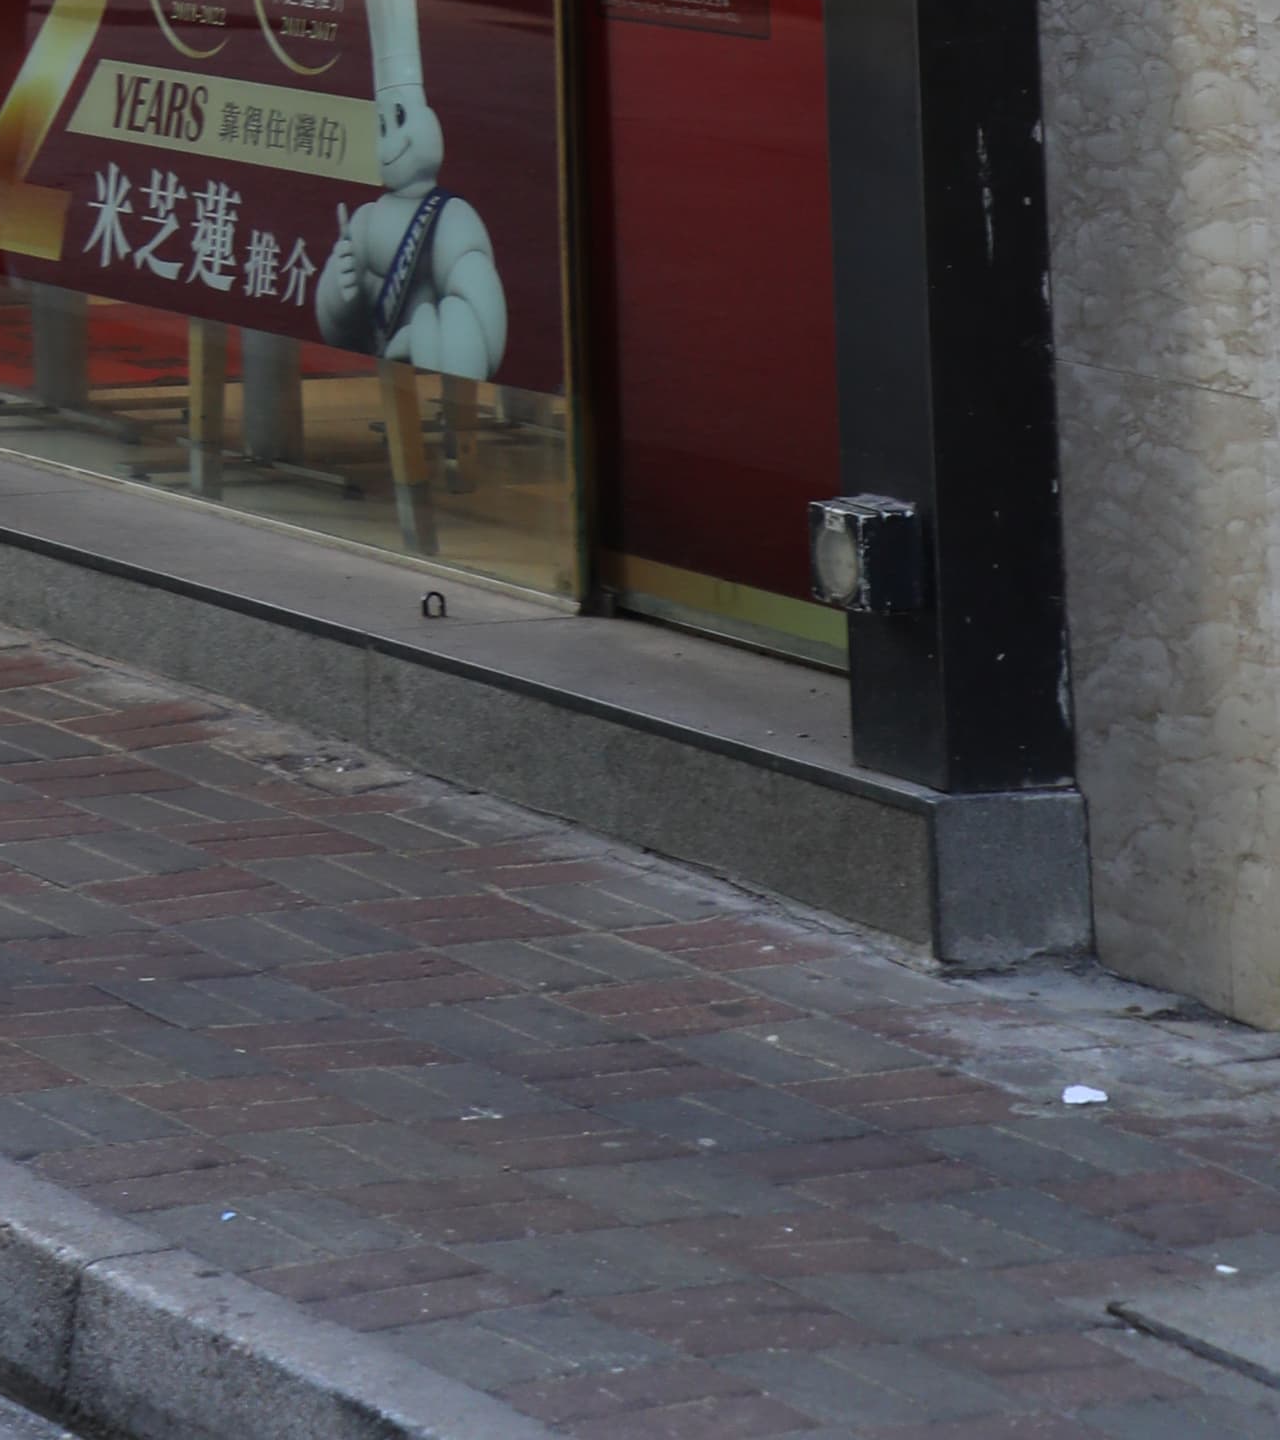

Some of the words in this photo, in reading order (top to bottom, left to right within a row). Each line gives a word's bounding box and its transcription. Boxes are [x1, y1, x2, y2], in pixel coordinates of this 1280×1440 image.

[113, 72, 209, 143] YEARS
[217, 100, 347, 166] 靠得住(灣仔)
[83, 161, 317, 307] 米芝蓮推介
